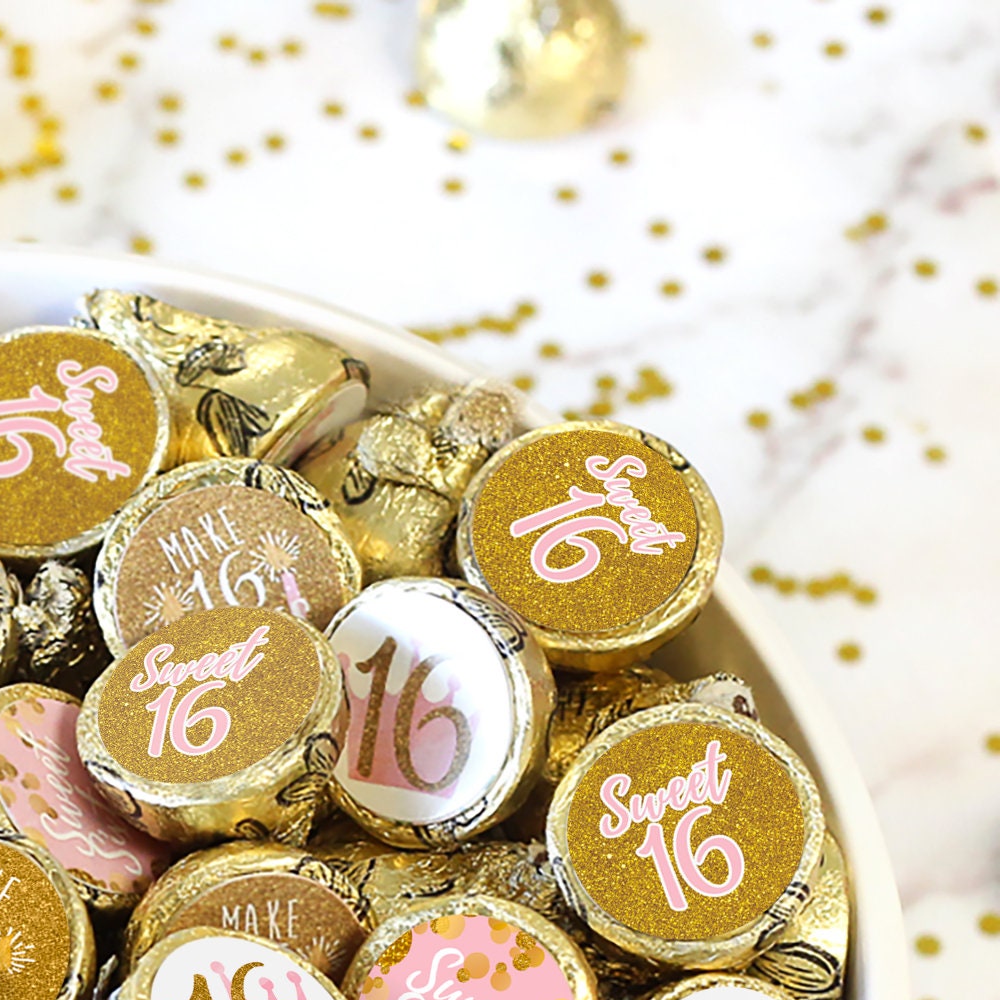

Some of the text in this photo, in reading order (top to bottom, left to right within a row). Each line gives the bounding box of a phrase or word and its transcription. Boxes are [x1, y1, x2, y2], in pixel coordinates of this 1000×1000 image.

[57, 358, 131, 482] Sweet
[157, 506, 245, 574] MAKE
[510, 485, 628, 583] 16
[585, 454, 686, 556] Sweet
[188, 550, 267, 611] 16
[129, 625, 270, 692] Sweet
[144, 681, 231, 759] 16
[354, 636, 474, 792] 16
[16, 729, 96, 857] Sweet
[599, 740, 734, 839] Sweet
[636, 805, 746, 913] 16
[221, 898, 299, 940] MAKE
